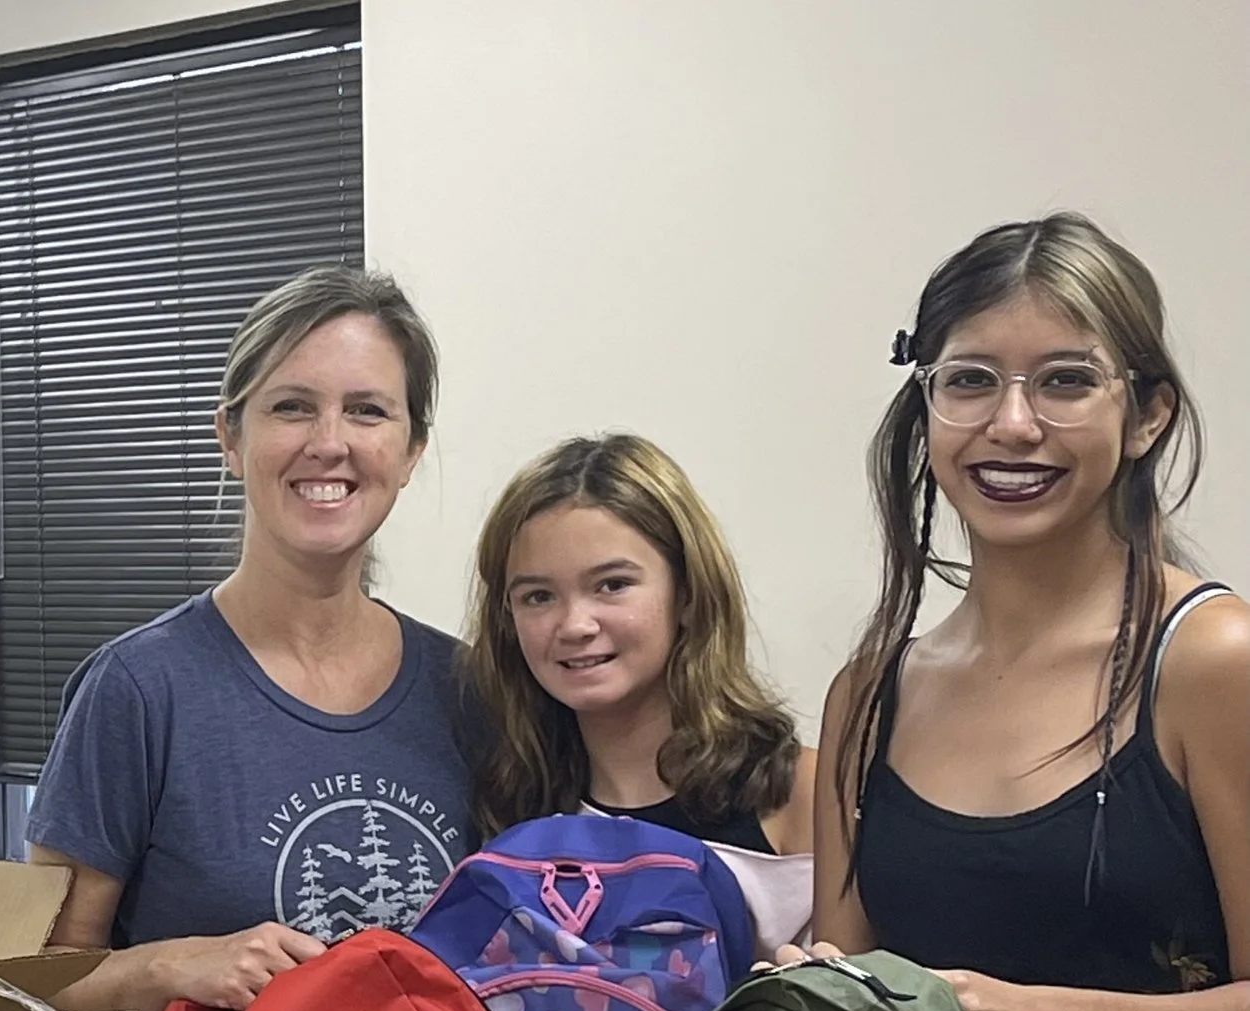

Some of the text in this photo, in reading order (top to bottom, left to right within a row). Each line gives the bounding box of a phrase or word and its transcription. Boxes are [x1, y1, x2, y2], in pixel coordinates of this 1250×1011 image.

[260, 773, 460, 848] LIVE LIFE SIMPLE
